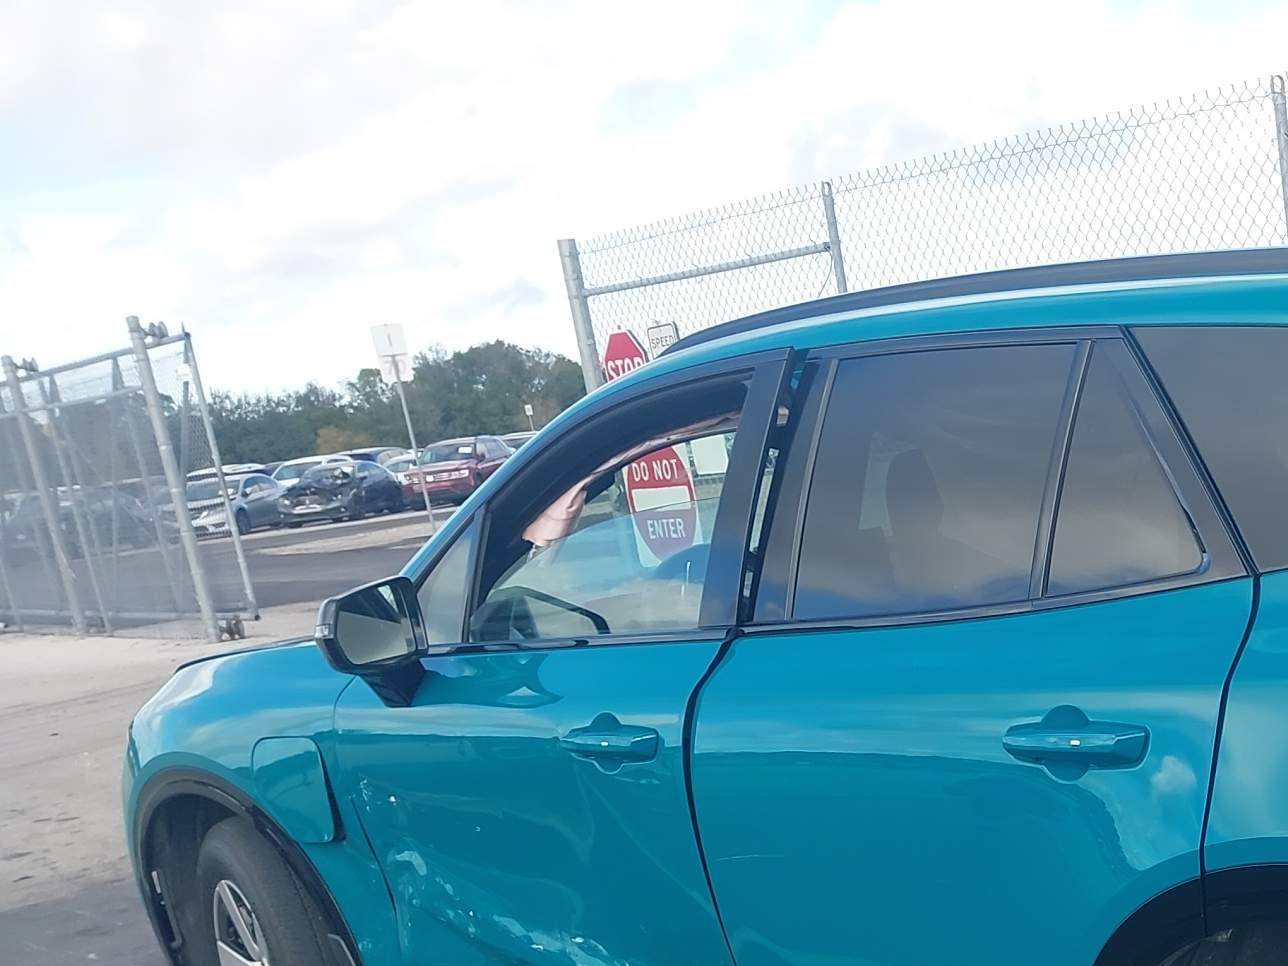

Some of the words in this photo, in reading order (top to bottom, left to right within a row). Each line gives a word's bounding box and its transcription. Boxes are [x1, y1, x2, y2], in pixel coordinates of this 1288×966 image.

[651, 335, 674, 349] SPEED
[606, 356, 644, 380] STOP
[631, 461, 649, 482] DO
[652, 459, 678, 481] NOT
[646, 518, 686, 539] ENTER
